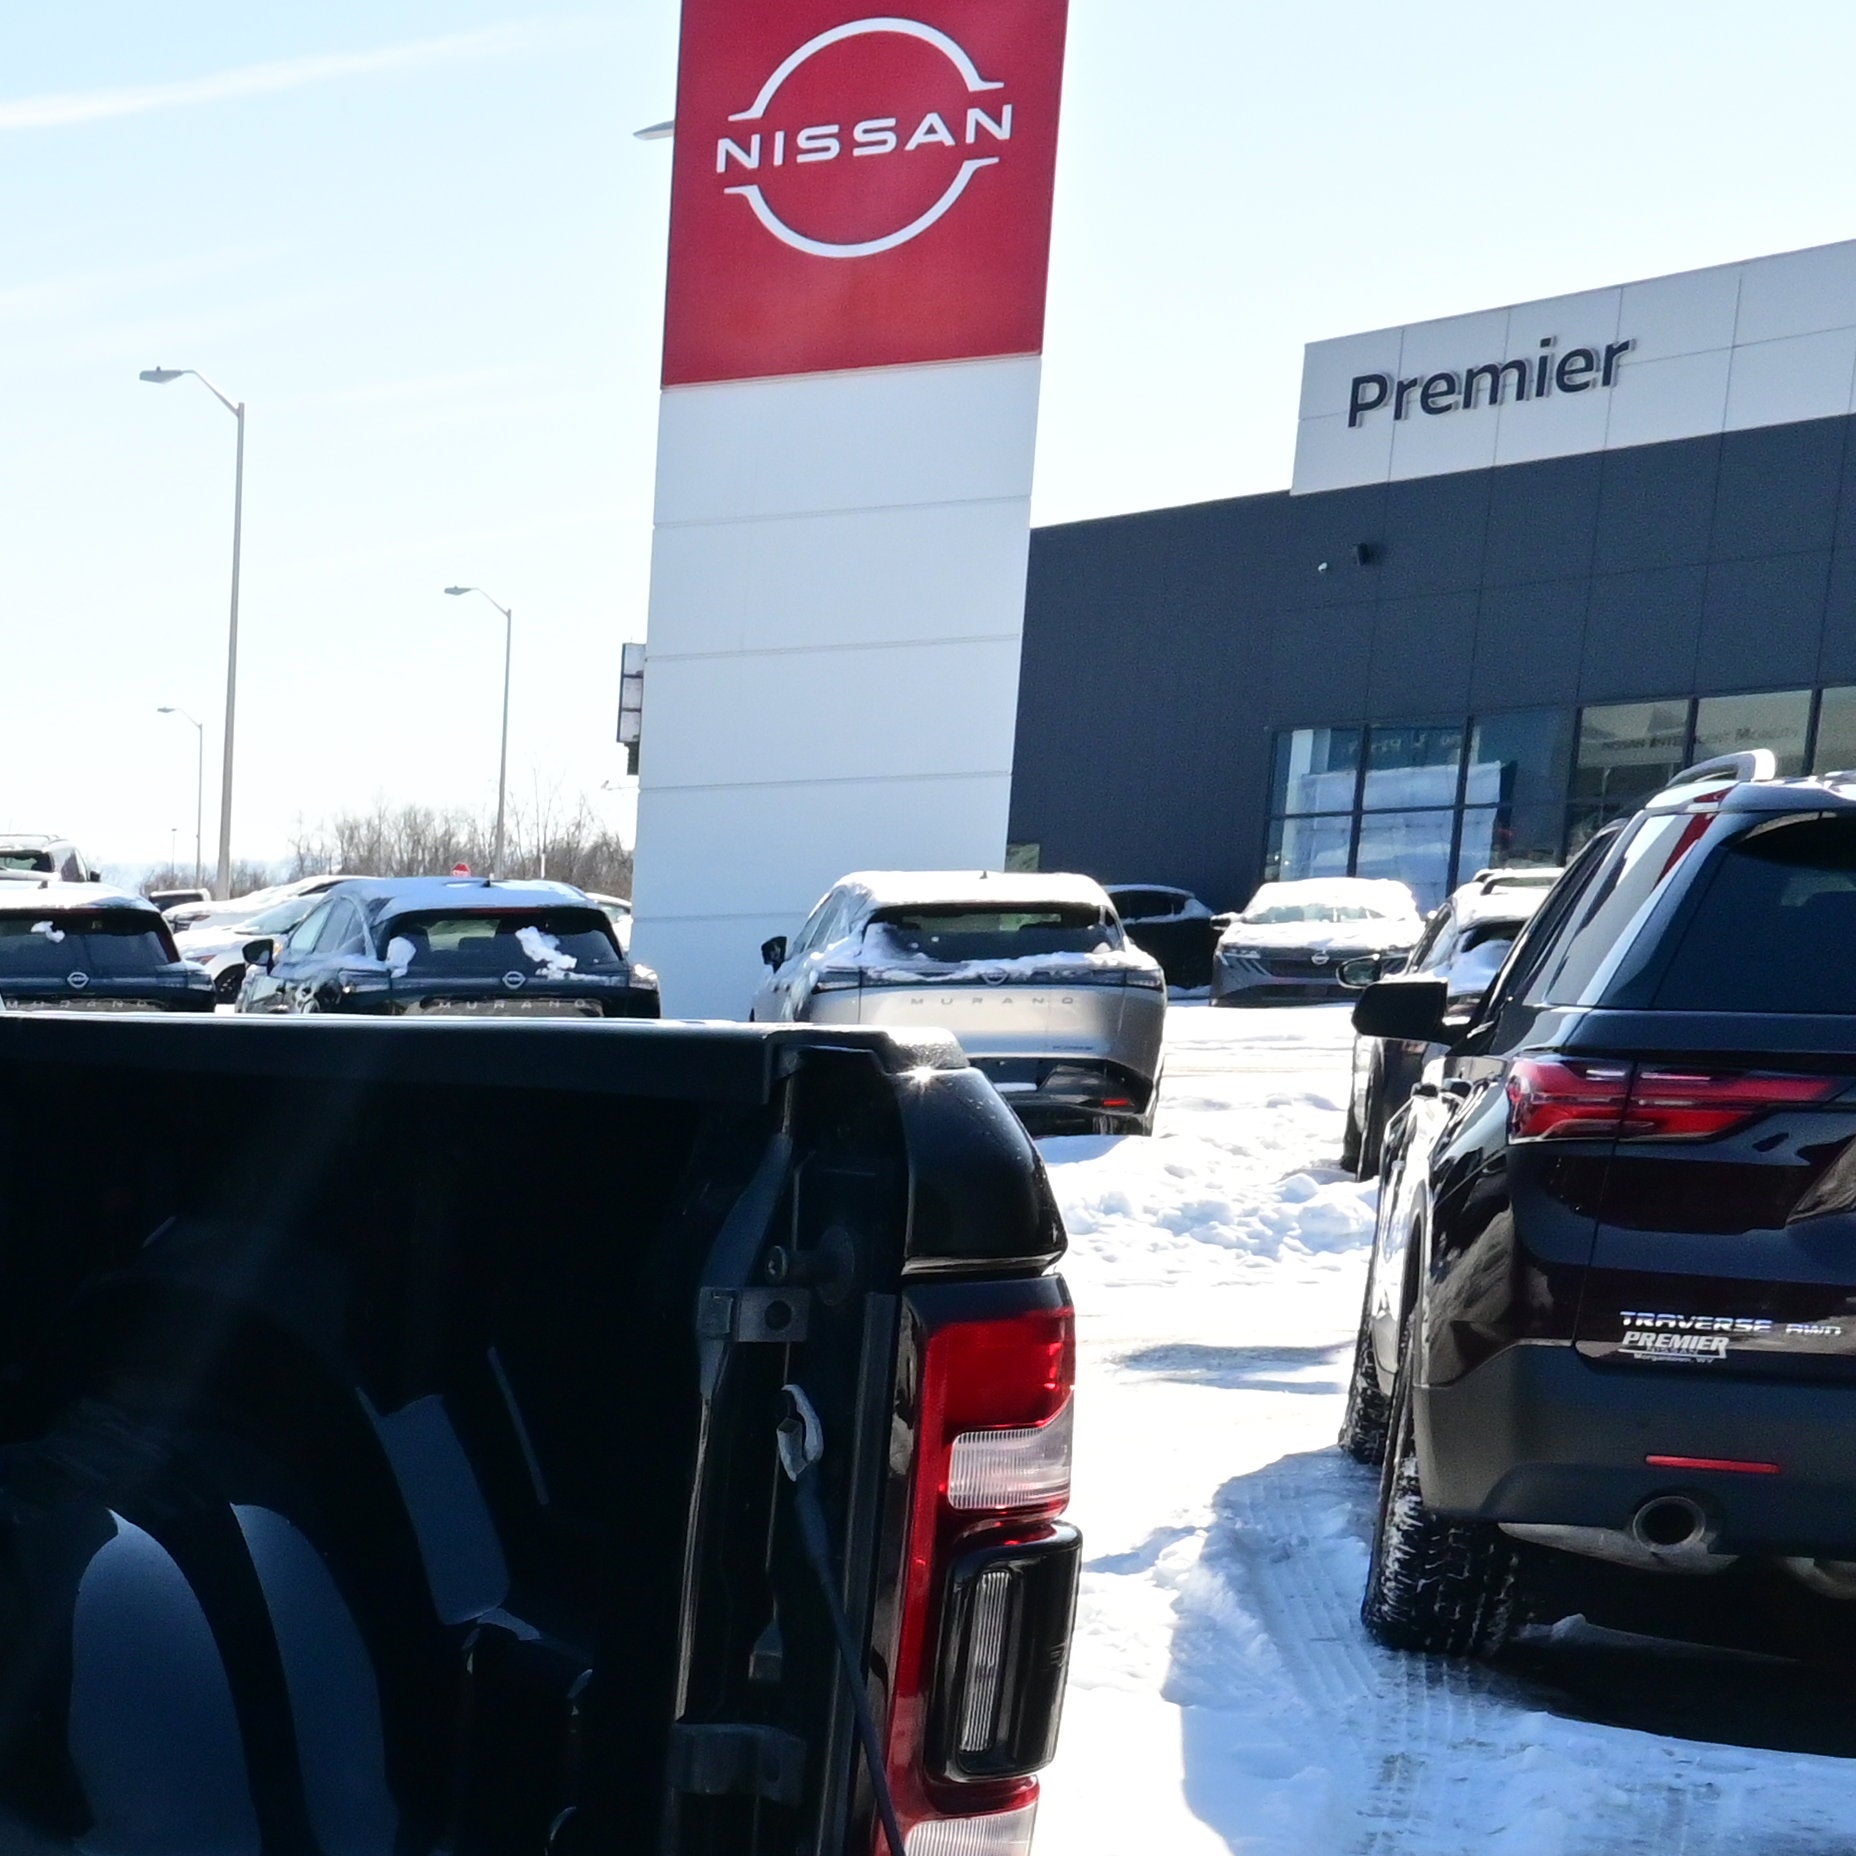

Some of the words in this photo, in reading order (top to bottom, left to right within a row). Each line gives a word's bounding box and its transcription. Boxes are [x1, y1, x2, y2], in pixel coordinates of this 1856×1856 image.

[716, 104, 1012, 173] NISSAN
[1348, 336, 1634, 428] Premier
[439, 999, 586, 1009] MURANO
[911, 996, 1074, 1005] MURANO
[1619, 1311, 1773, 1333] TRAVERSE
[1785, 1323, 1842, 1335] AWD
[1621, 1331, 1729, 1353] PREMIER
